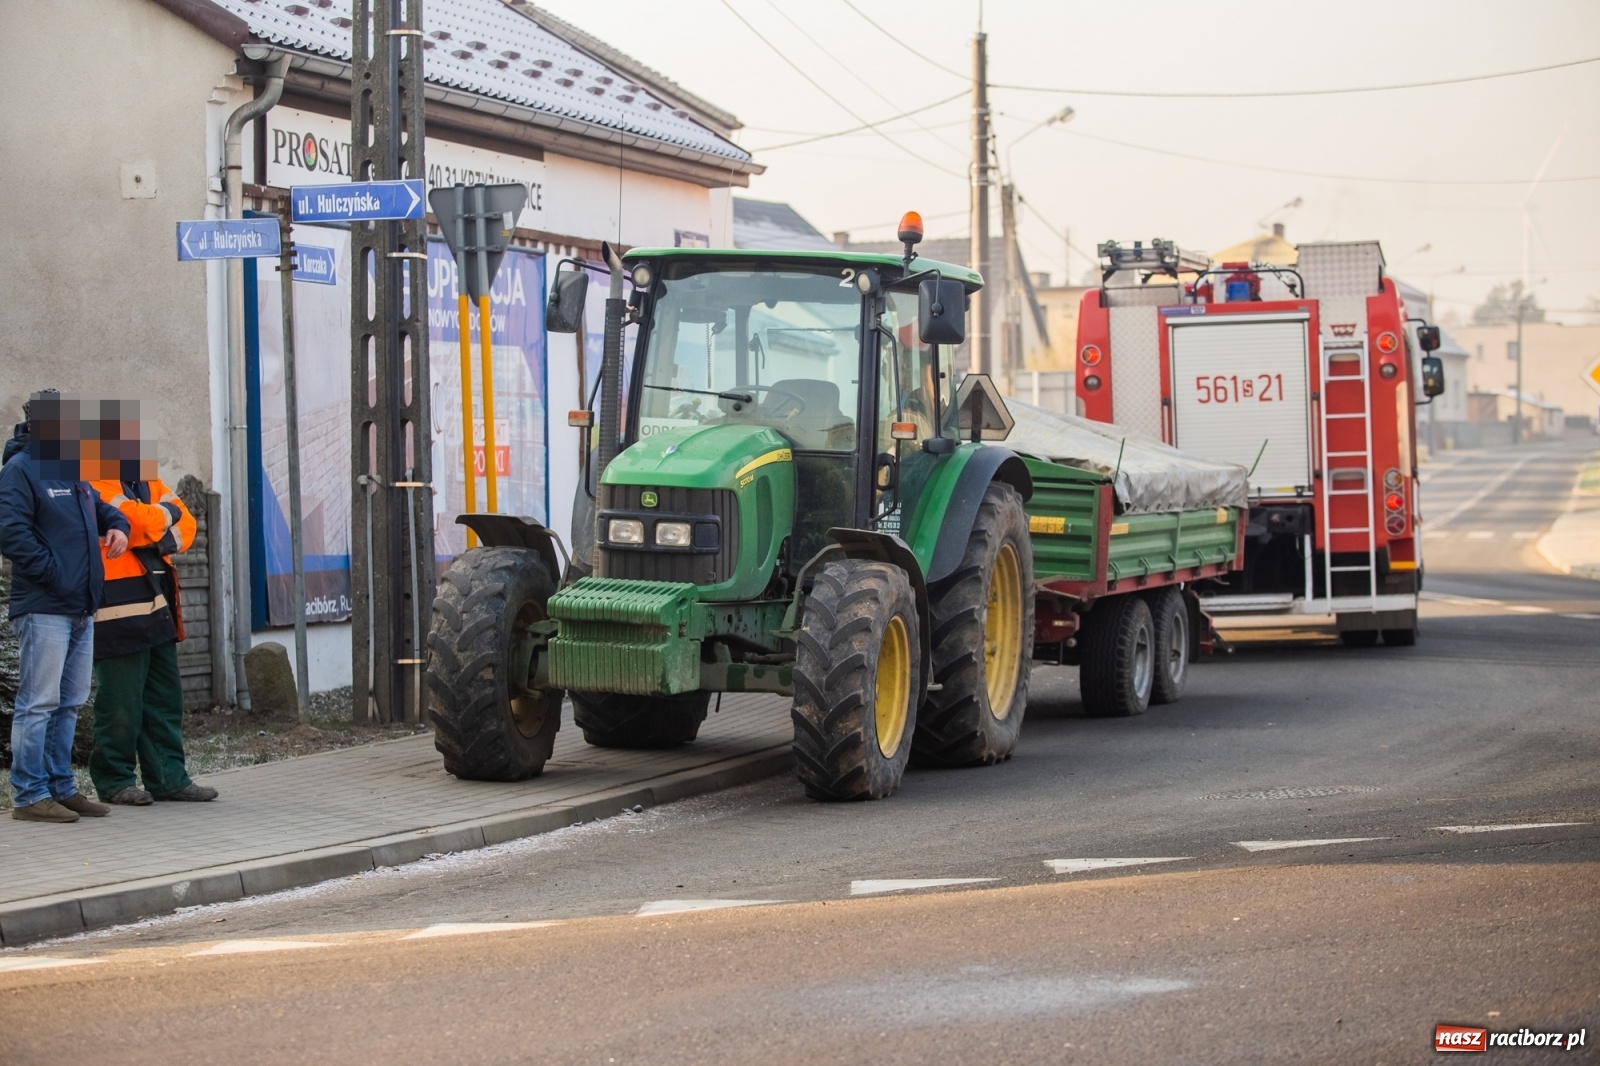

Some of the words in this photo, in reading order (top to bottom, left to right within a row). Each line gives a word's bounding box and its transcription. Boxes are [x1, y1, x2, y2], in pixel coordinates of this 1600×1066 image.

[298, 200, 314, 215] ul.
[318, 191, 381, 217] Hulczyńska
[214, 229, 262, 253] Hulczyńska
[303, 253, 327, 275] Korczaka
[838, 268, 856, 288] 2
[1196, 375, 1239, 404] 561
[1258, 373, 1283, 402] 21
[305, 594, 339, 616] acibórz,
